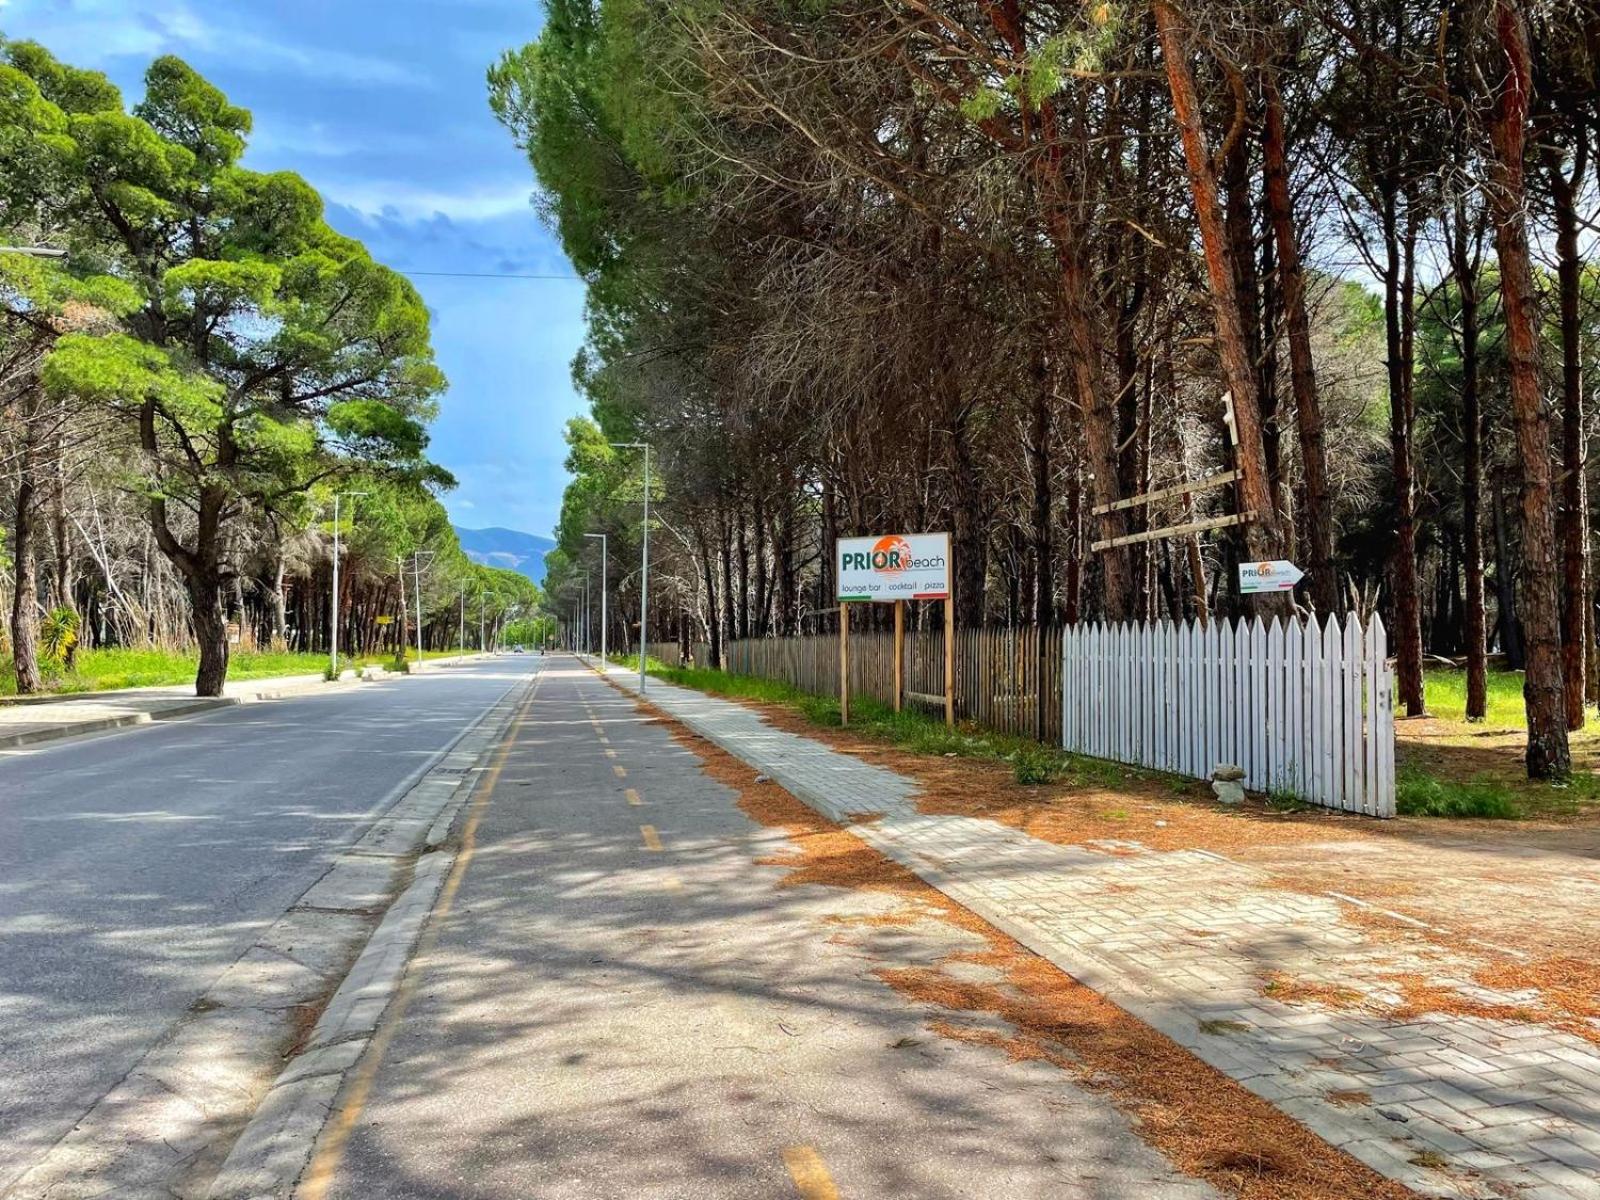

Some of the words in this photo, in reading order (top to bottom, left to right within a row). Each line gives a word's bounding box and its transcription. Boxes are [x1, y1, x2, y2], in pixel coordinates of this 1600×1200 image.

[842, 552, 901, 571] PRIOR
[906, 555, 945, 569] beach
[1242, 568, 1271, 577] PRIOR
[842, 584, 866, 593] lounge
[868, 584, 881, 592] bar
[888, 581, 917, 591] cocktail
[924, 582, 945, 590] pizza
